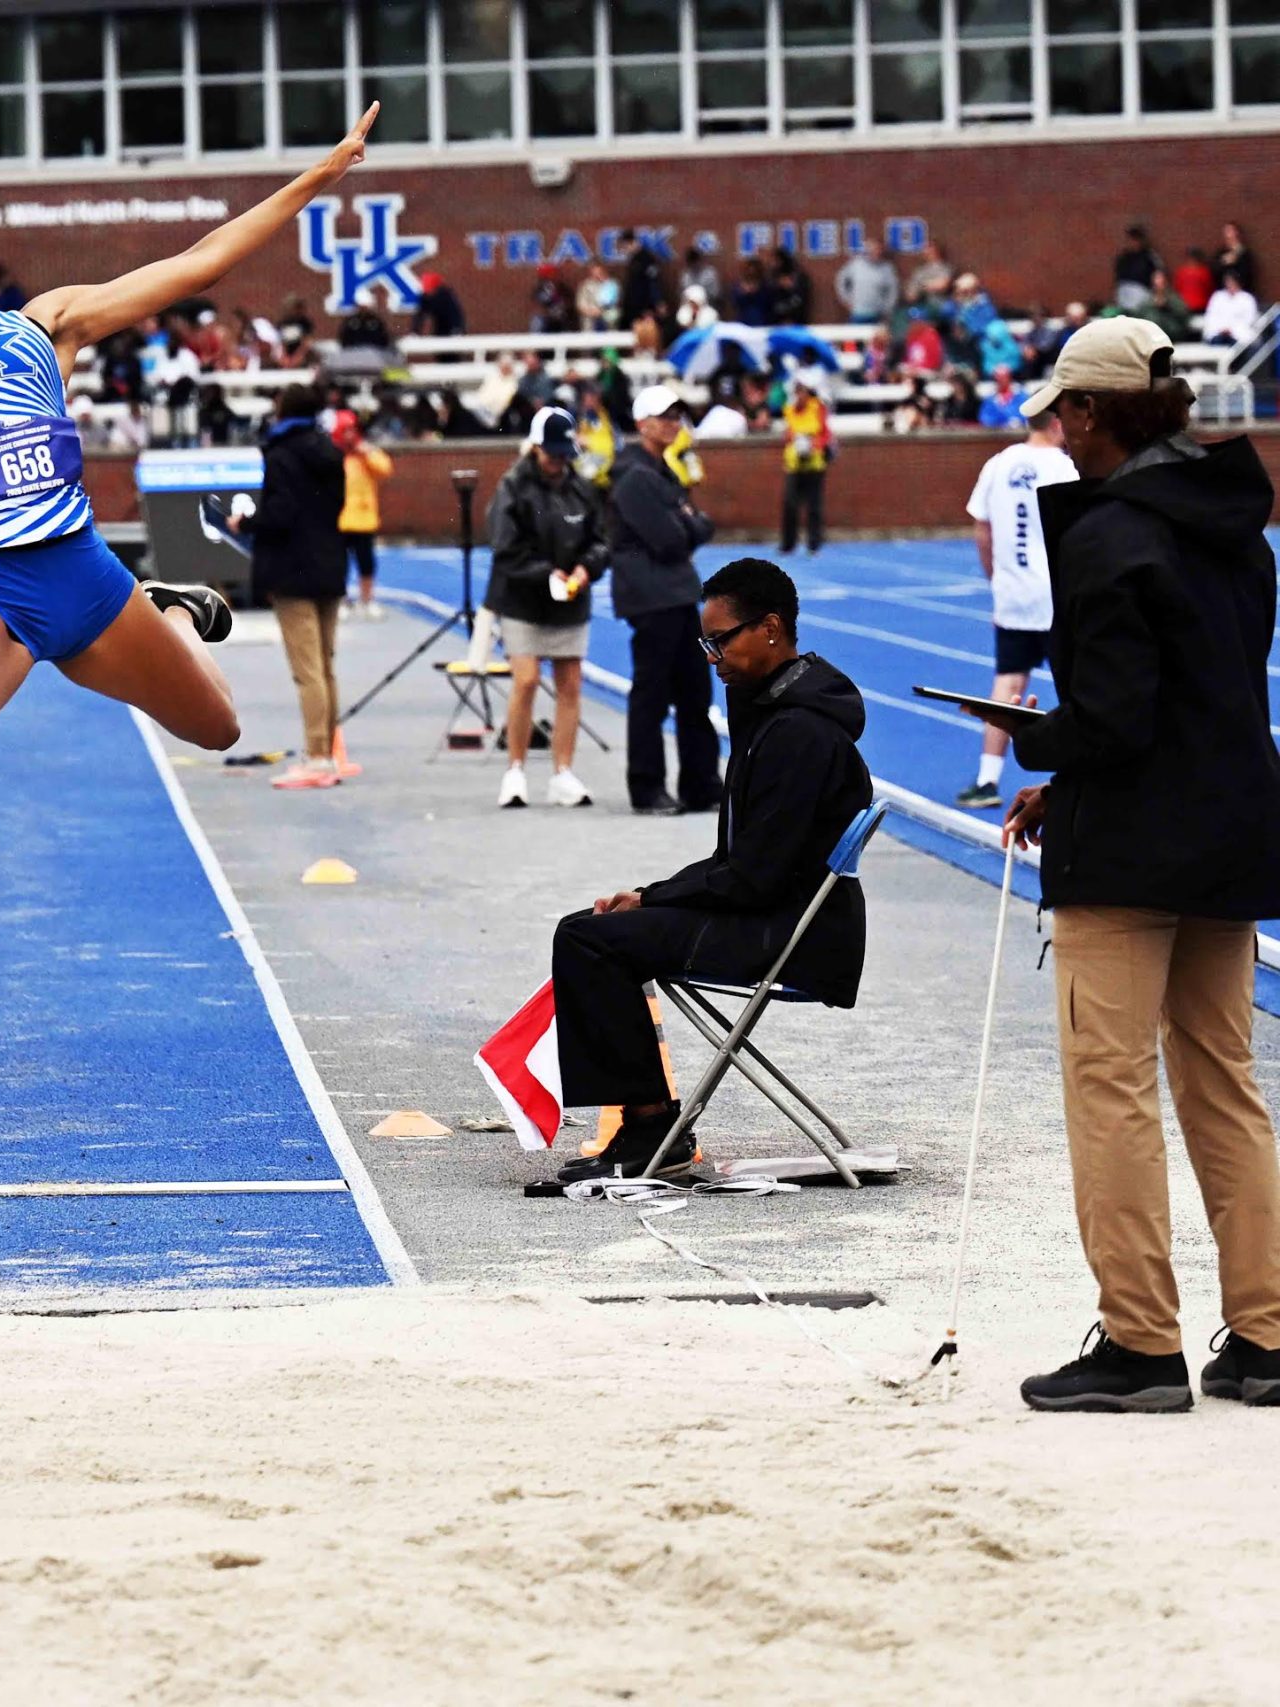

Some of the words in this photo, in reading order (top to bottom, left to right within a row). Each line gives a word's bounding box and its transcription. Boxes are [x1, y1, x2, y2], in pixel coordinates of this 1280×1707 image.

[300, 194, 438, 315] UK
[466, 224, 677, 268] TRACK
[736, 216, 929, 257] FIELD
[0, 444, 55, 486] 658
[21, 482, 40, 494] STATE
